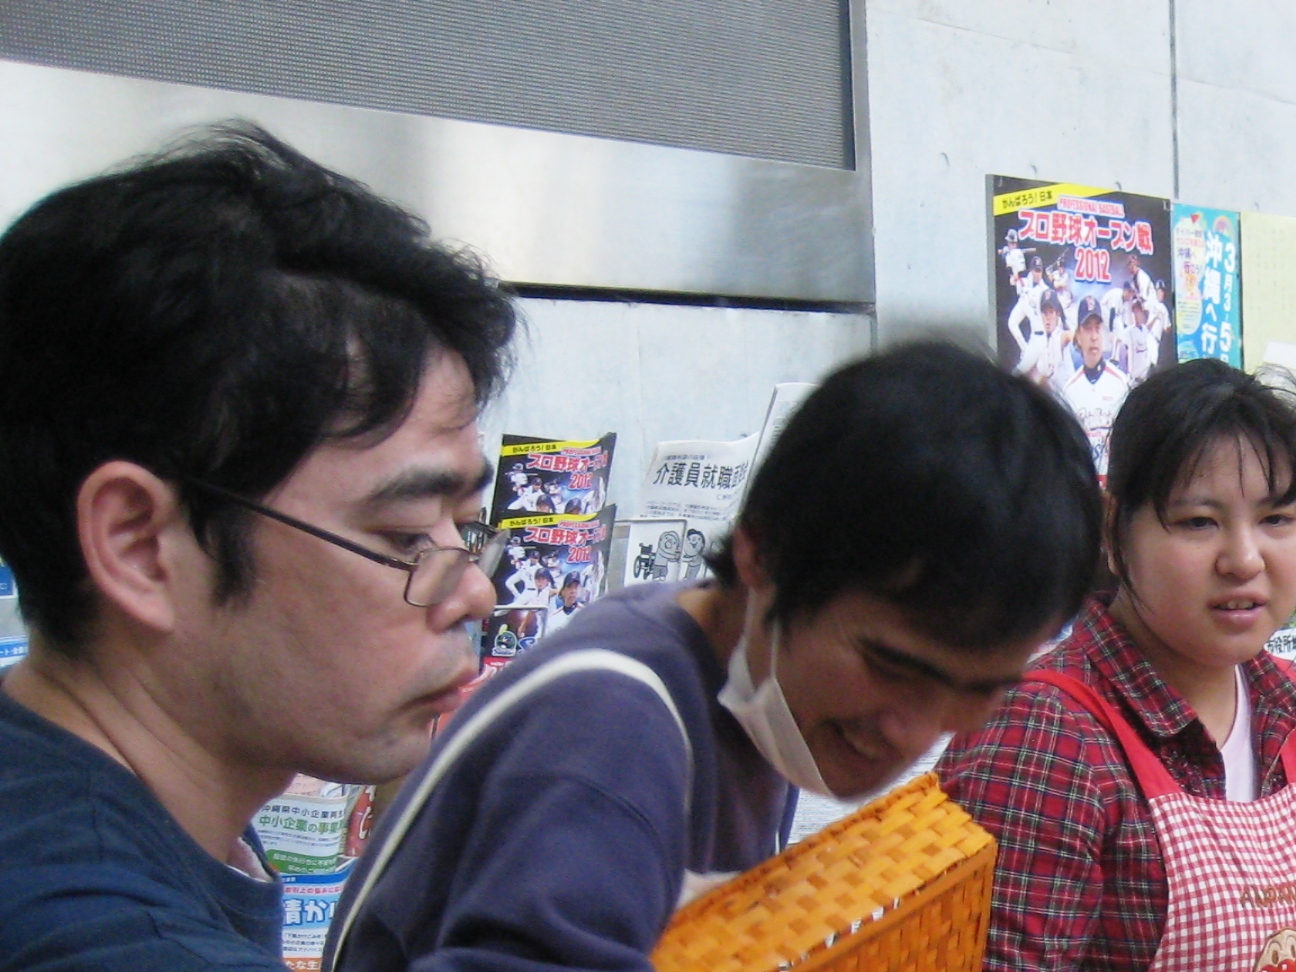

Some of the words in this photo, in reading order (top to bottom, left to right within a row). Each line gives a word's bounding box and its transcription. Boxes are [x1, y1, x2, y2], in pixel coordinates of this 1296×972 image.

[1018, 210, 1153, 255] プロ野球オープン戦
[1075, 248, 1111, 283] 2012
[1201, 231, 1223, 360] 沖縄へ行
[568, 472, 593, 489] 2012
[566, 545, 592, 563] 2012
